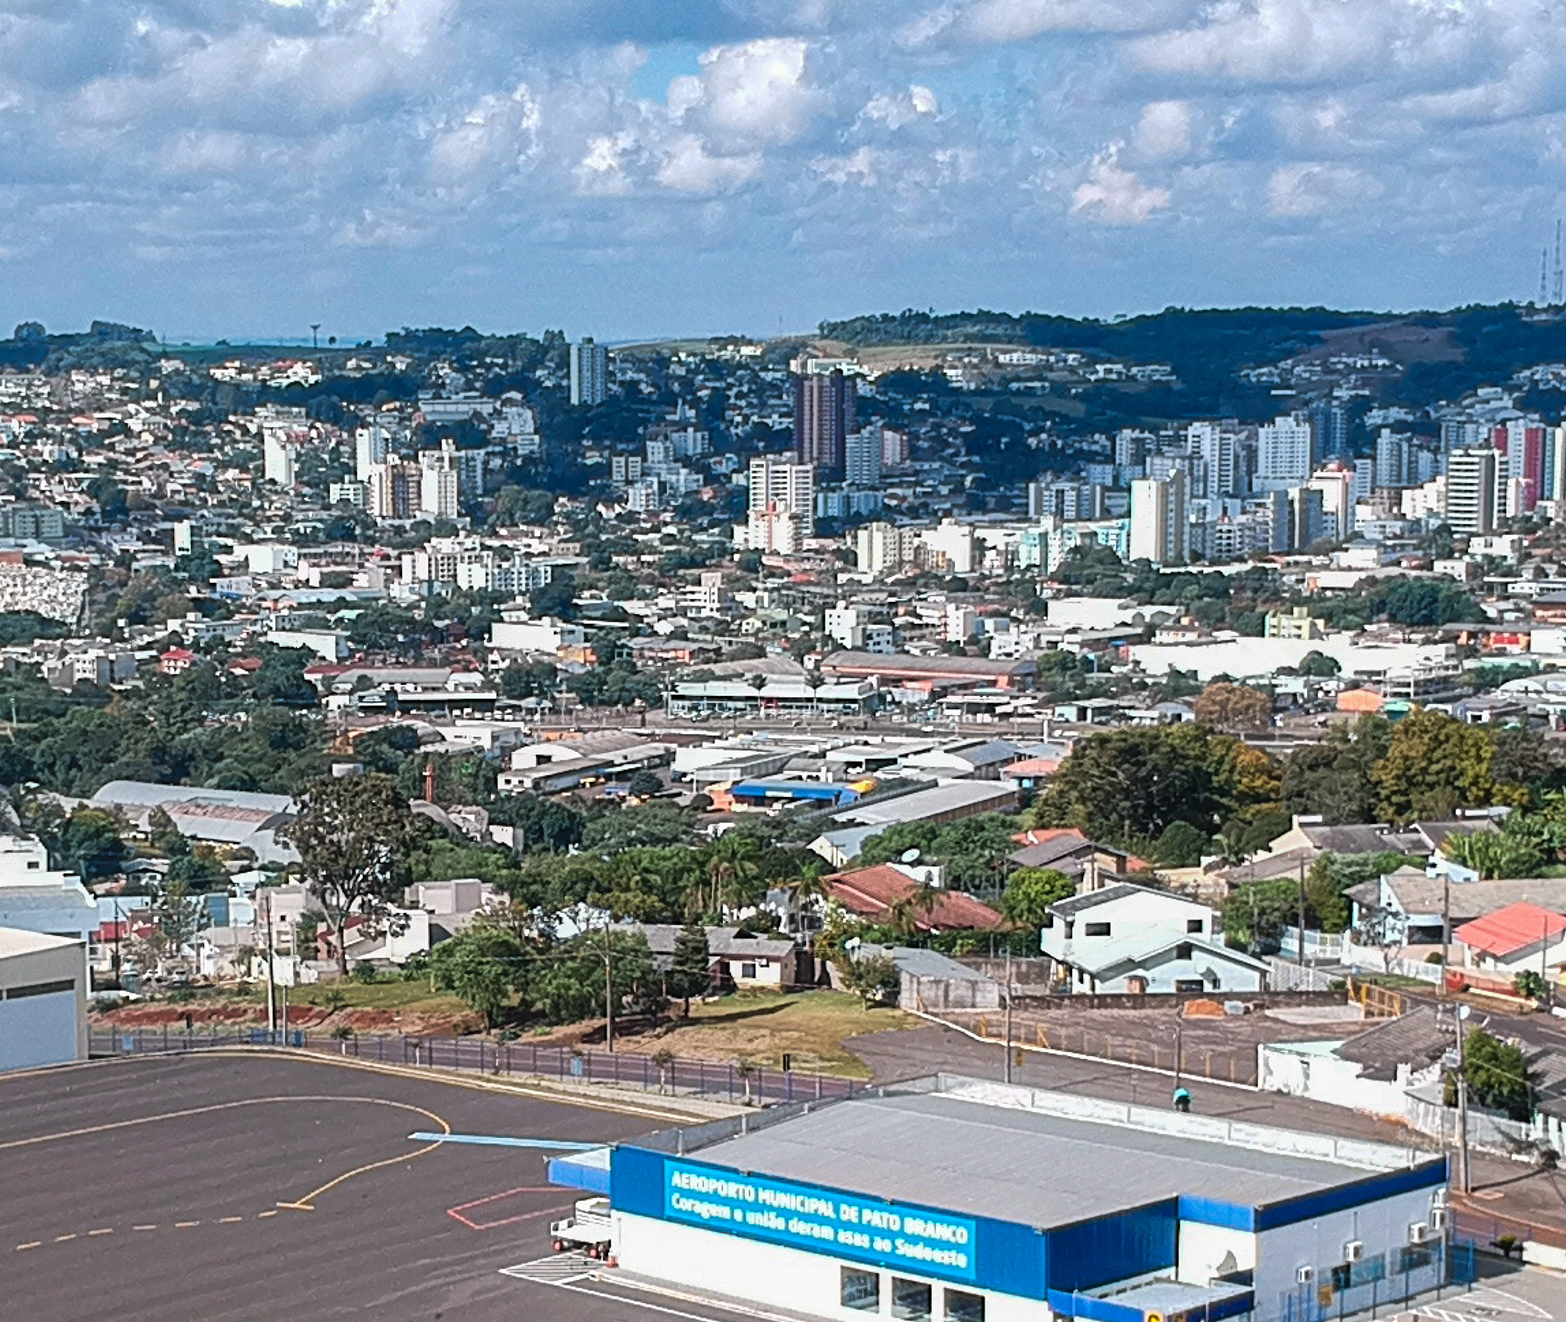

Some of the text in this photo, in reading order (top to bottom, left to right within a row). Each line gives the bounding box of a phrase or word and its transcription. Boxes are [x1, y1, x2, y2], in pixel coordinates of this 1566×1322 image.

[671, 1171, 968, 1244] AEROPORTO MUNICIPAL DE PATO BRANCO
[671, 1192, 968, 1268] Coragem e união deram asas ao Sudoeste
